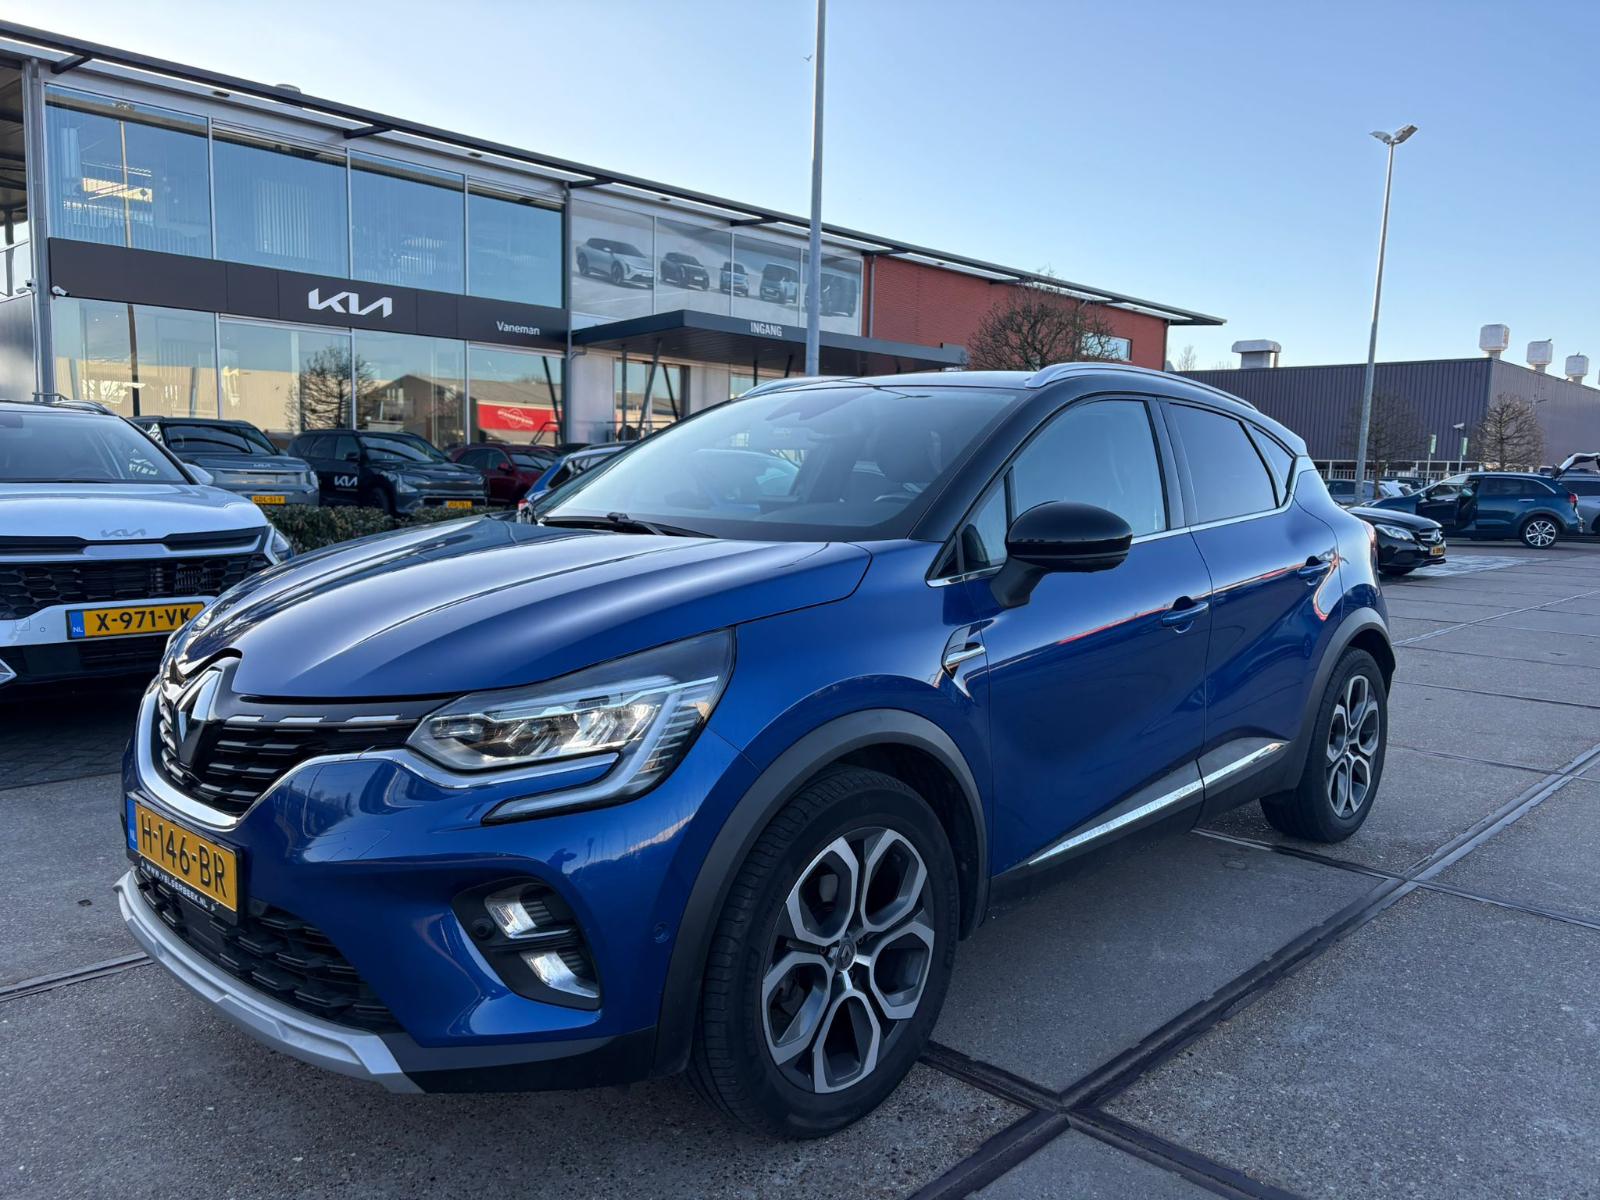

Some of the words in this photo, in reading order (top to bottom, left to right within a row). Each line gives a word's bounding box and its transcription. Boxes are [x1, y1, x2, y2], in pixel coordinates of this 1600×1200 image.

[308, 287, 393, 318] KIA
[496, 320, 541, 336] Vaneman
[751, 321, 783, 336] INGANG
[72, 624, 84, 634] NL
[95, 607, 191, 632] X-971-VK
[141, 811, 226, 898] H-146-BR
